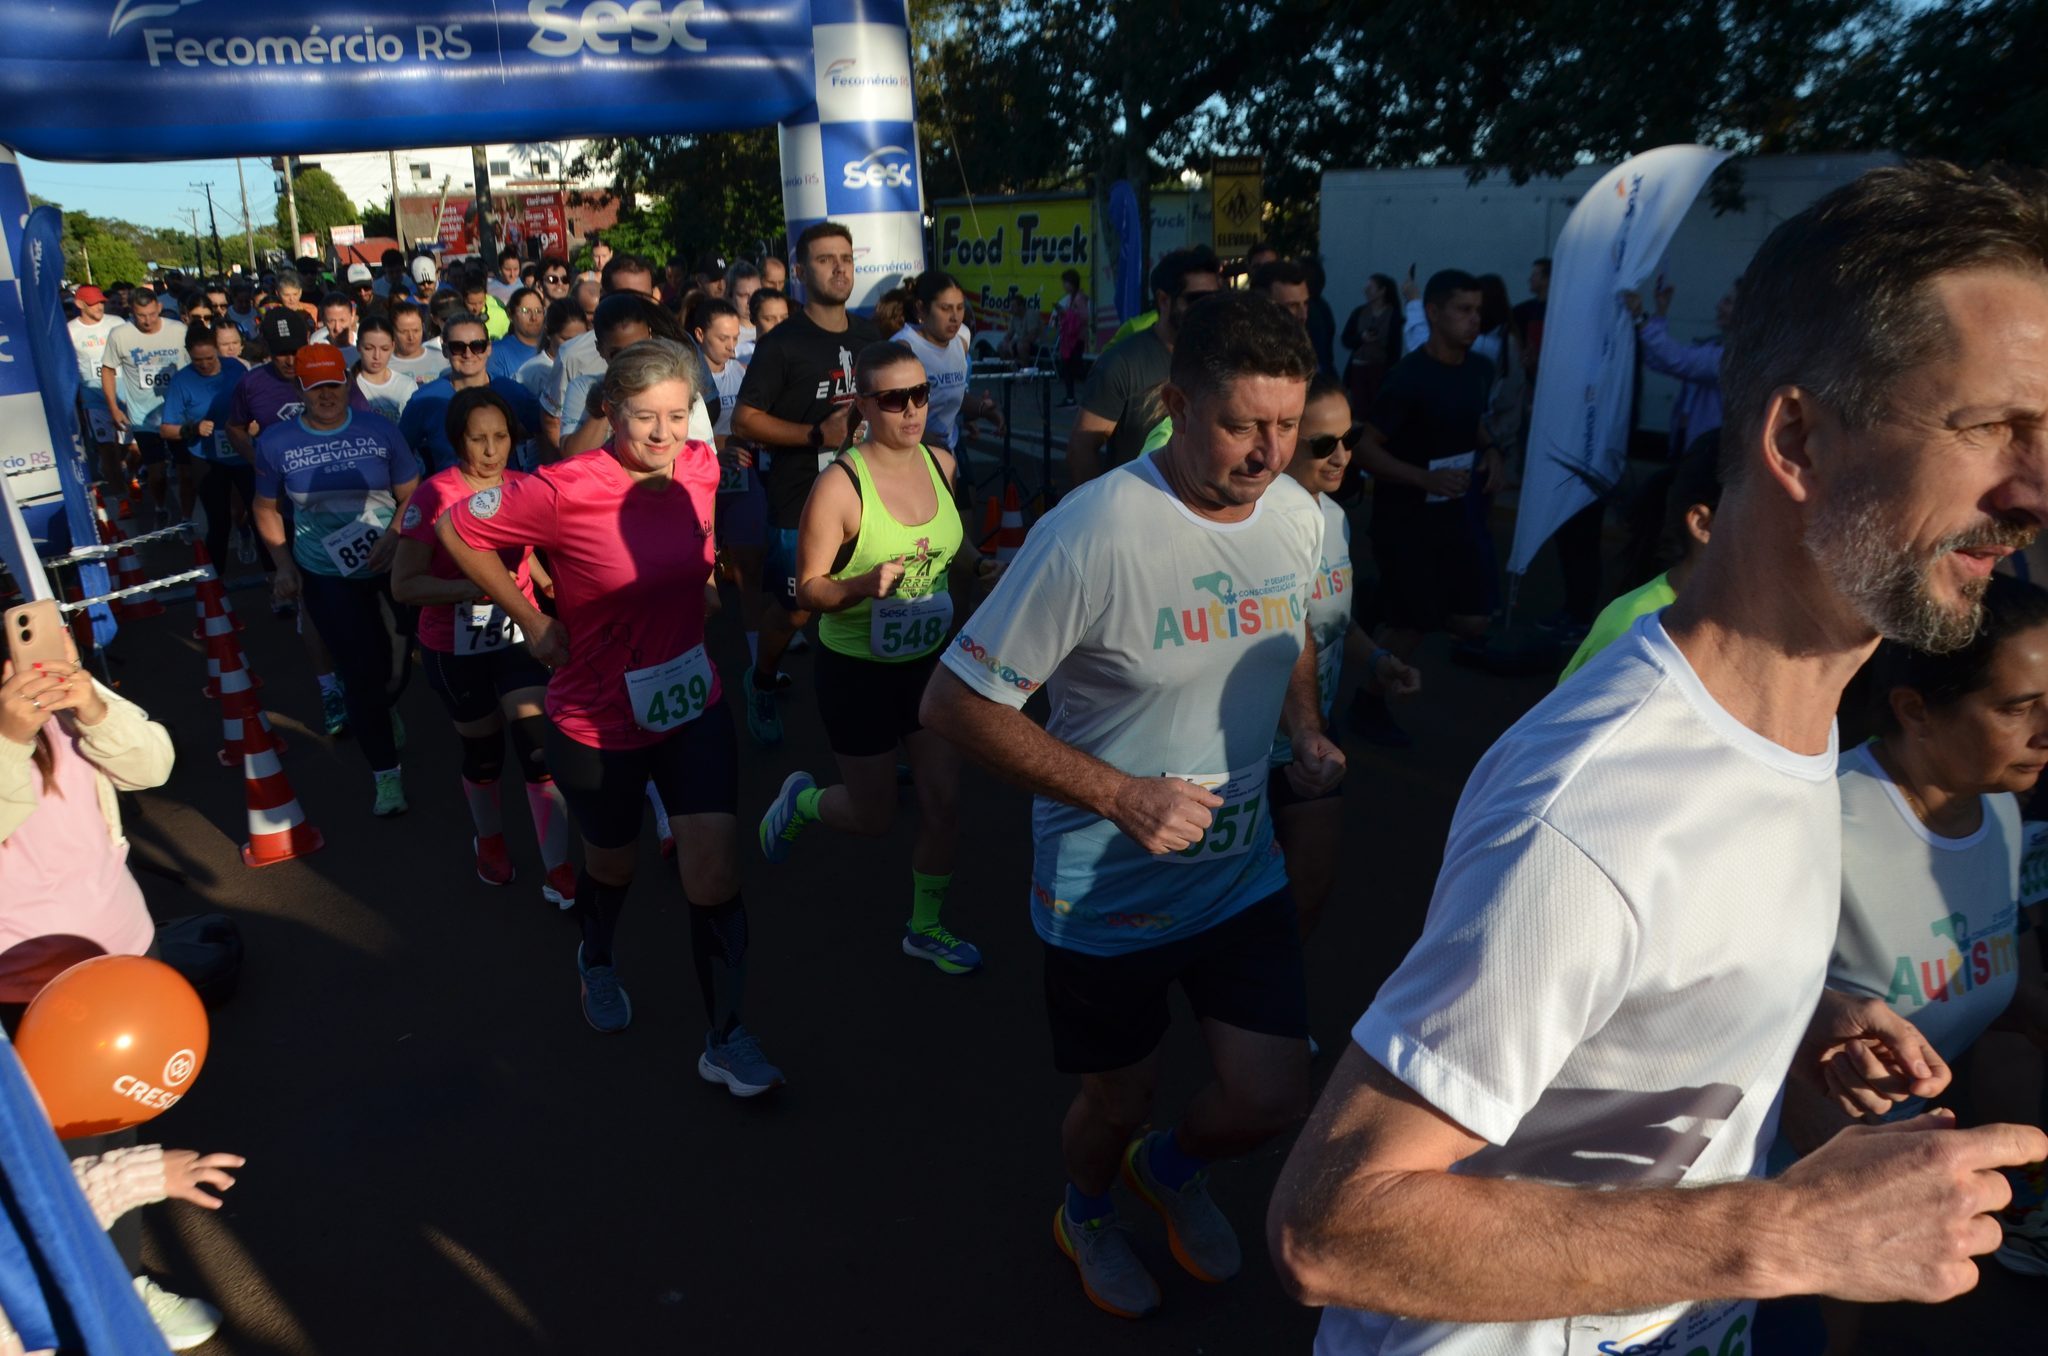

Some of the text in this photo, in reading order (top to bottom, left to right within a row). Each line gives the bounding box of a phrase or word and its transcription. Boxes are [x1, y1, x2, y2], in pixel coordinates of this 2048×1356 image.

[142, 23, 472, 68] Fecomércio RS
[527, 0, 708, 58] Sesc
[831, 73, 899, 88] Fecomércio
[842, 160, 913, 189] Sesc
[942, 213, 1089, 267] Food Truck
[1008, 285, 1041, 310] Tck
[145, 373, 171, 387] 669
[30, 451, 52, 465] RS
[284, 437, 379, 462] RÚSTICA DA
[882, 616, 943, 653] 548
[1152, 593, 1302, 650] Autismo
[647, 674, 708, 726] 439
[1885, 933, 2020, 1007] Autism
